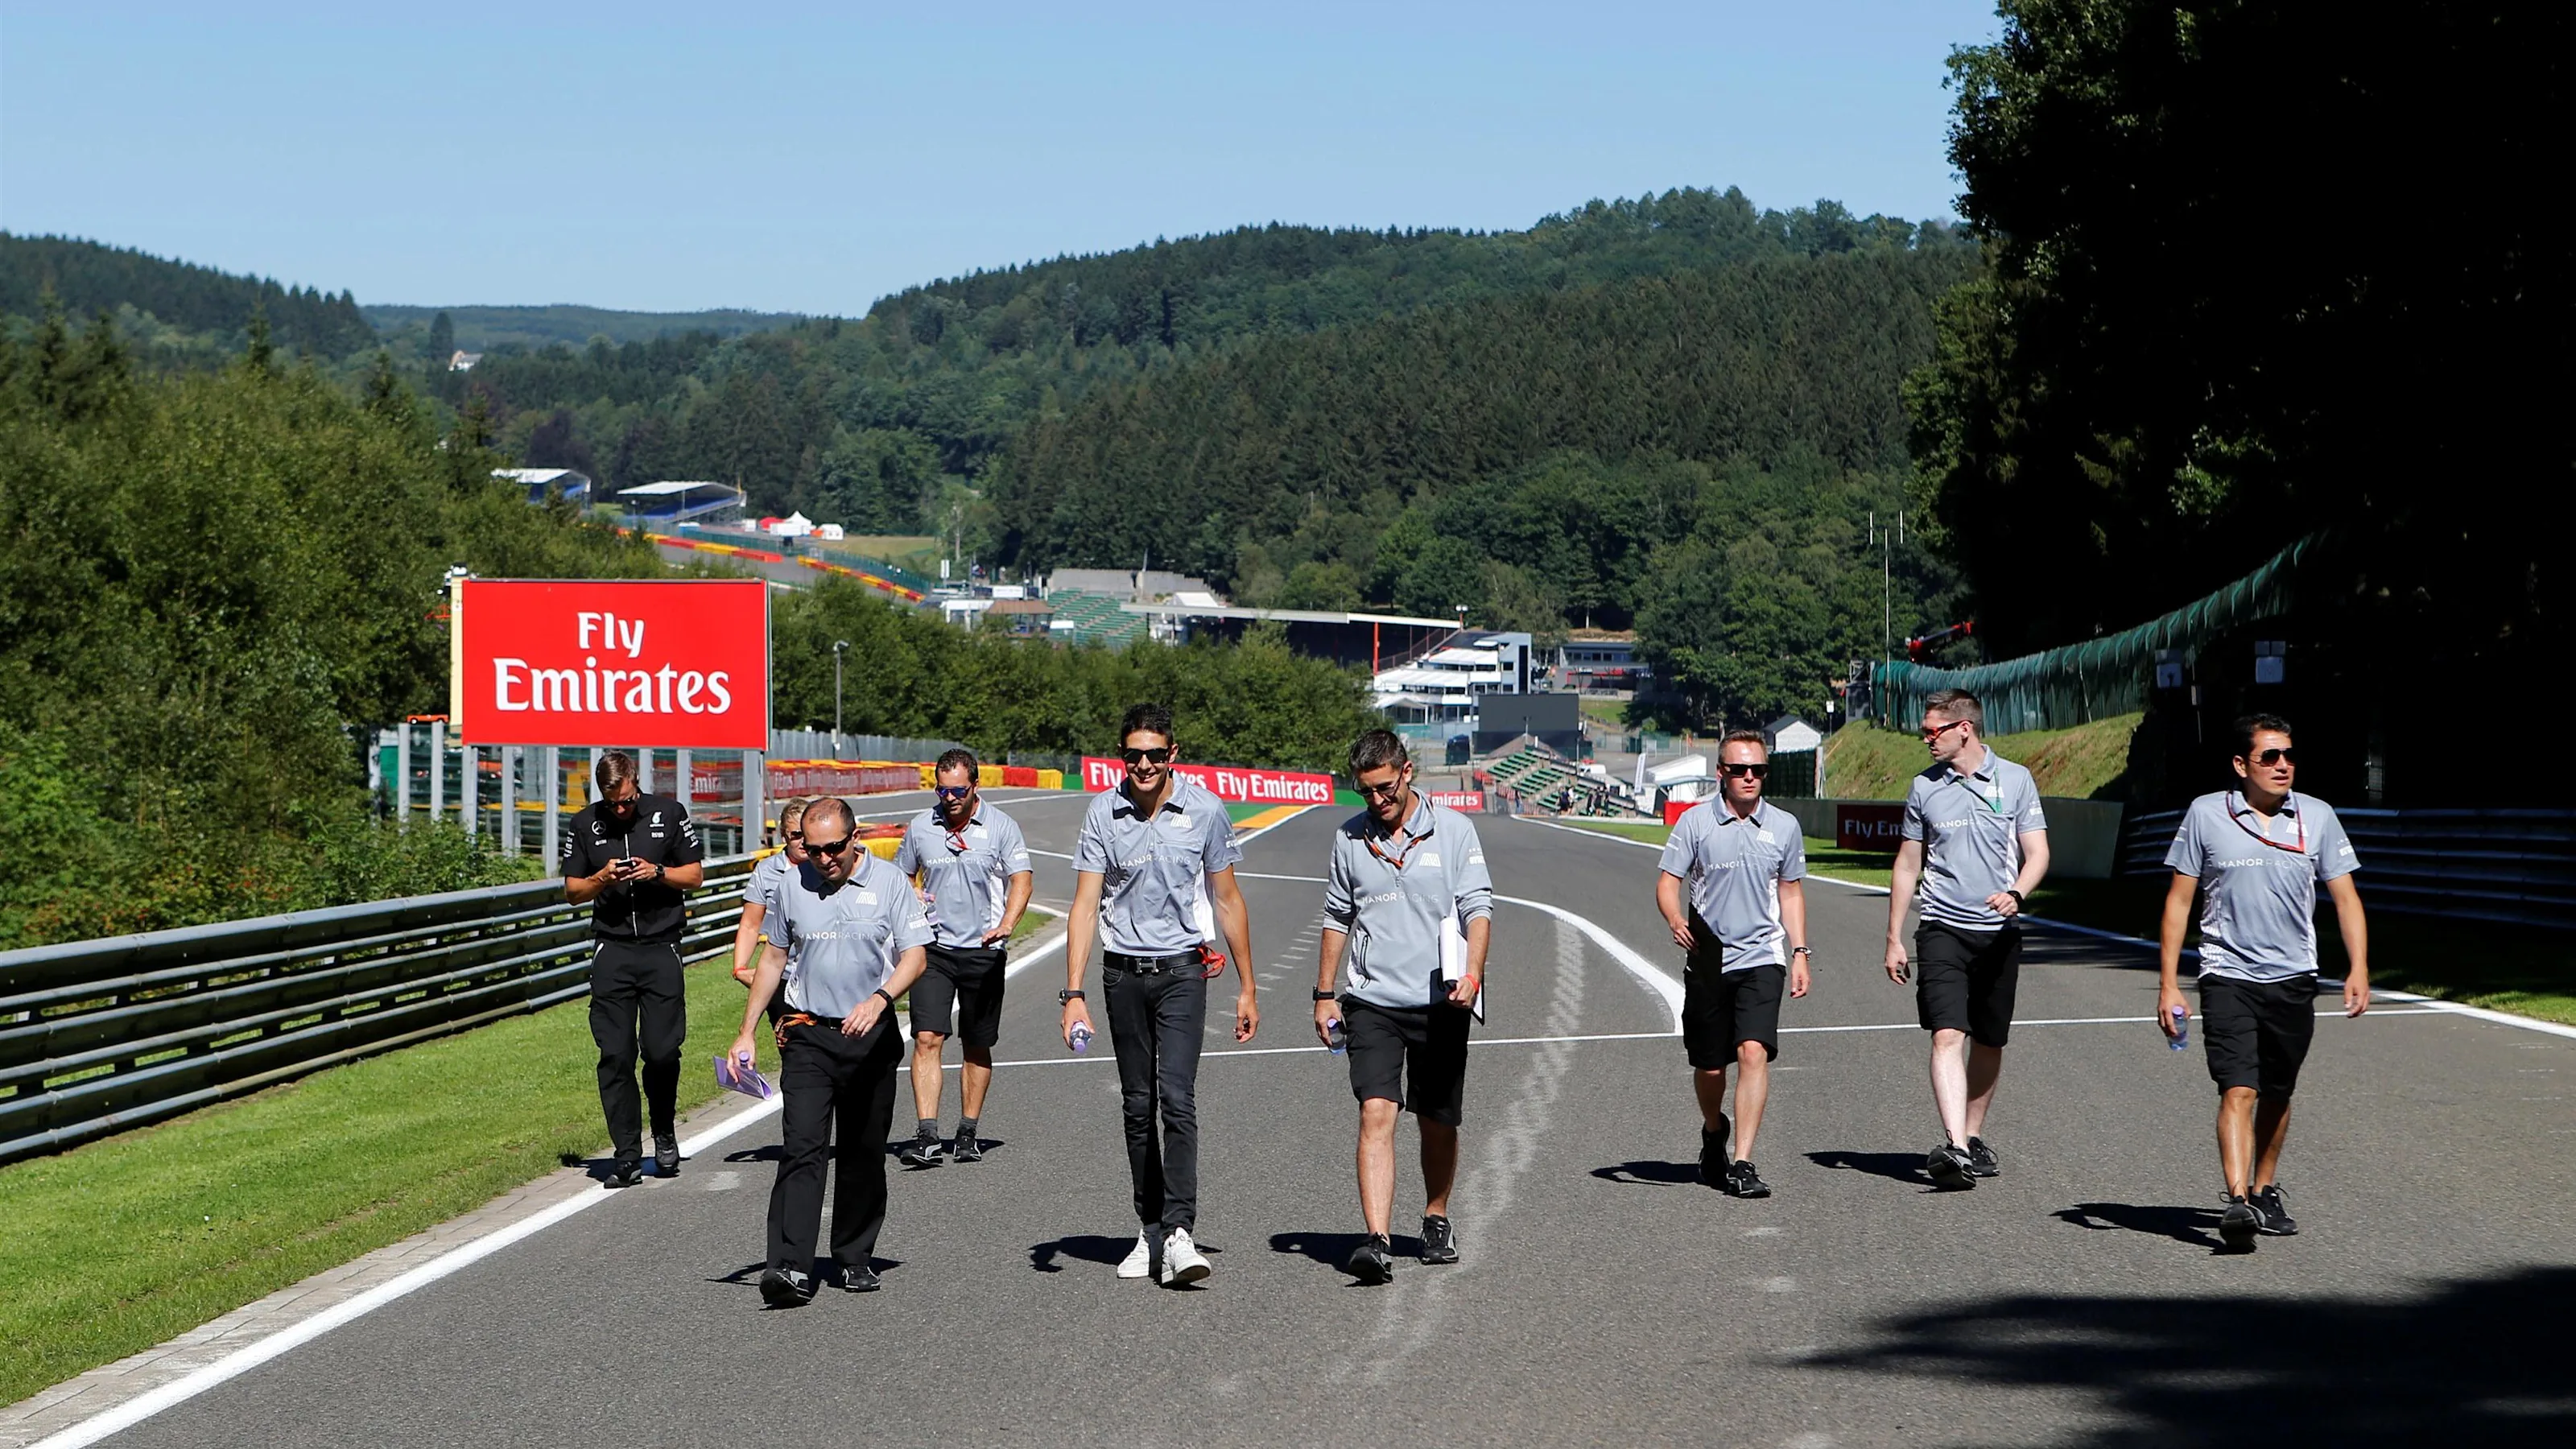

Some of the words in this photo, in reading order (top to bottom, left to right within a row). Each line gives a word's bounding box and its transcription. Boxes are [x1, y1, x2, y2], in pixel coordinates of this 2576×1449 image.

[577, 612, 644, 658] Fly
[493, 656, 732, 714] Emirates
[1089, 762, 1122, 789] Fly
[1216, 770, 1248, 801] Fly
[1249, 773, 1329, 802] Emirates
[1426, 792, 1479, 807] mirates
[1844, 819, 1873, 838] Fly
[926, 857, 957, 866] MANOR
[2218, 857, 2264, 869] MANOR
